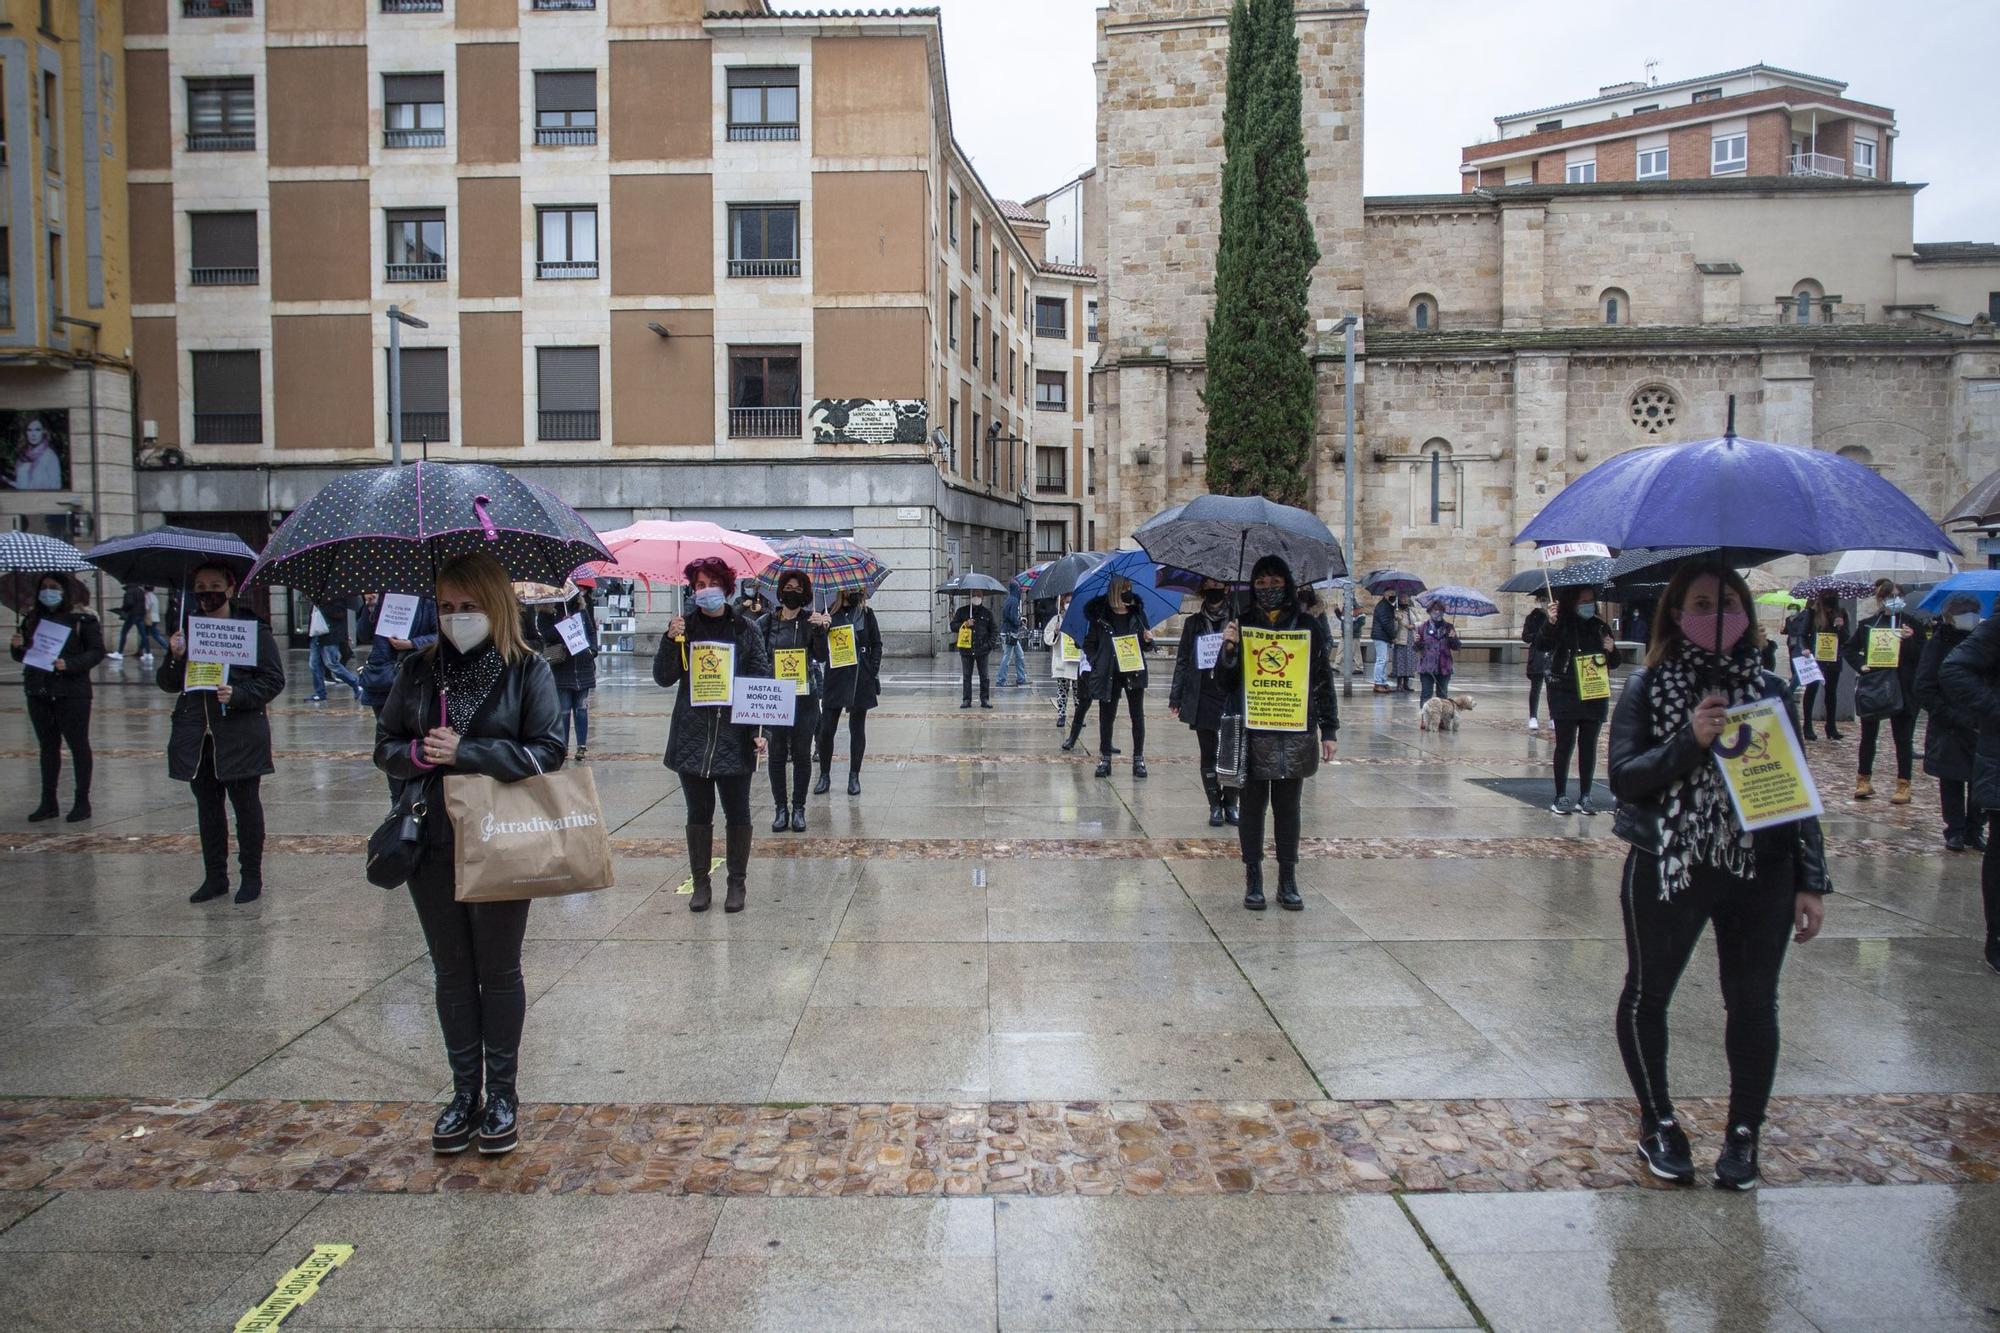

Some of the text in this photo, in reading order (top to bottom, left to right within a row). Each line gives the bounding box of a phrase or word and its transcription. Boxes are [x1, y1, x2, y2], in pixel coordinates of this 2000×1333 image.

[1564, 544, 1575, 553] AL
[195, 622, 236, 632] CORTARSE
[196, 631, 217, 639] PELO
[1255, 631, 1264, 639] 20
[1276, 633, 1307, 641] OCTUBRE
[199, 639, 243, 649] NECESIDAD
[1252, 679, 1293, 688] CIERRE
[746, 693, 768, 701] MOÑO
[750, 702, 764, 710] 21%
[736, 711, 750, 719] ¡IVA
[1742, 761, 1783, 777] CIERRE
[312, 1252, 338, 1269] POR
[278, 1269, 321, 1297] FAVOR
